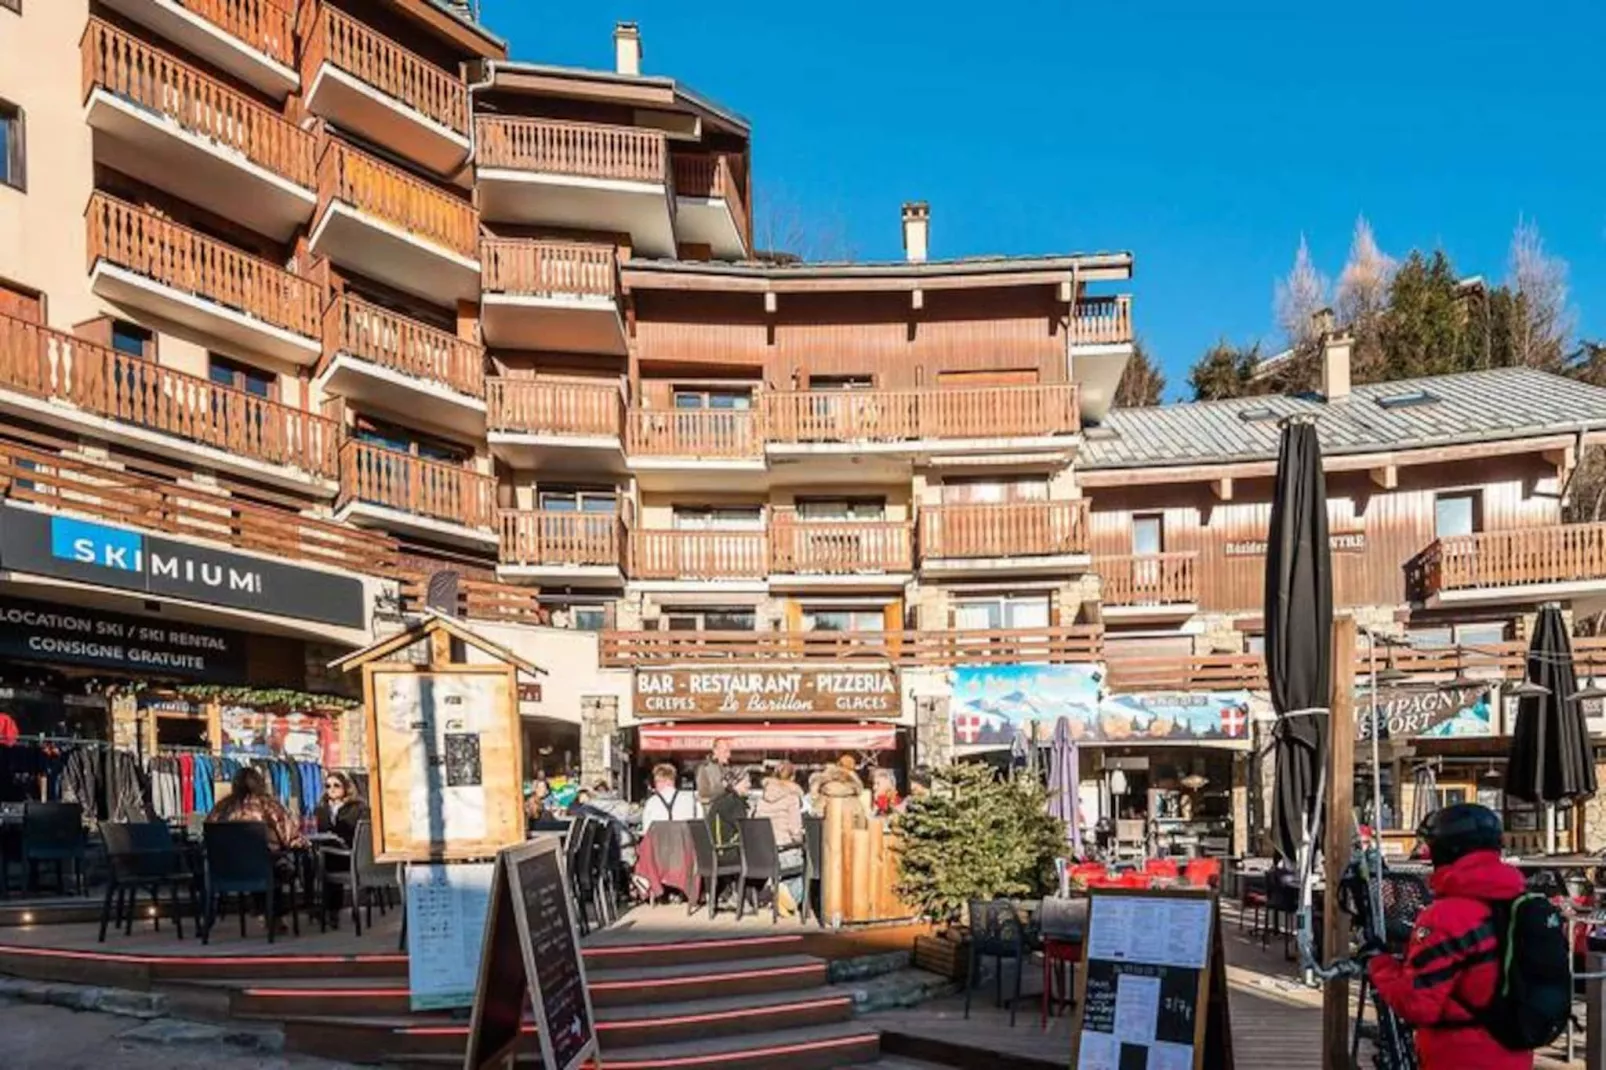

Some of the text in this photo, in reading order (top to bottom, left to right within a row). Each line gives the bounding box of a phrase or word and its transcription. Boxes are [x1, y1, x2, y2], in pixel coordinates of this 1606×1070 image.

[1329, 534, 1365, 549] NTRE
[73, 537, 255, 593] SKIMIUM
[0, 608, 91, 632] LOCATION
[96, 621, 124, 637] SKI
[139, 627, 165, 642] SKI
[169, 632, 226, 650] RENTAL
[28, 636, 205, 670] CONSIGNE GRATUITE
[638, 673, 674, 693] BAR
[689, 673, 801, 693] RESTAURANT
[817, 673, 896, 693] PIZZERIA
[836, 695, 888, 711] GLACES
[1353, 688, 1468, 723] AMPAGNY
